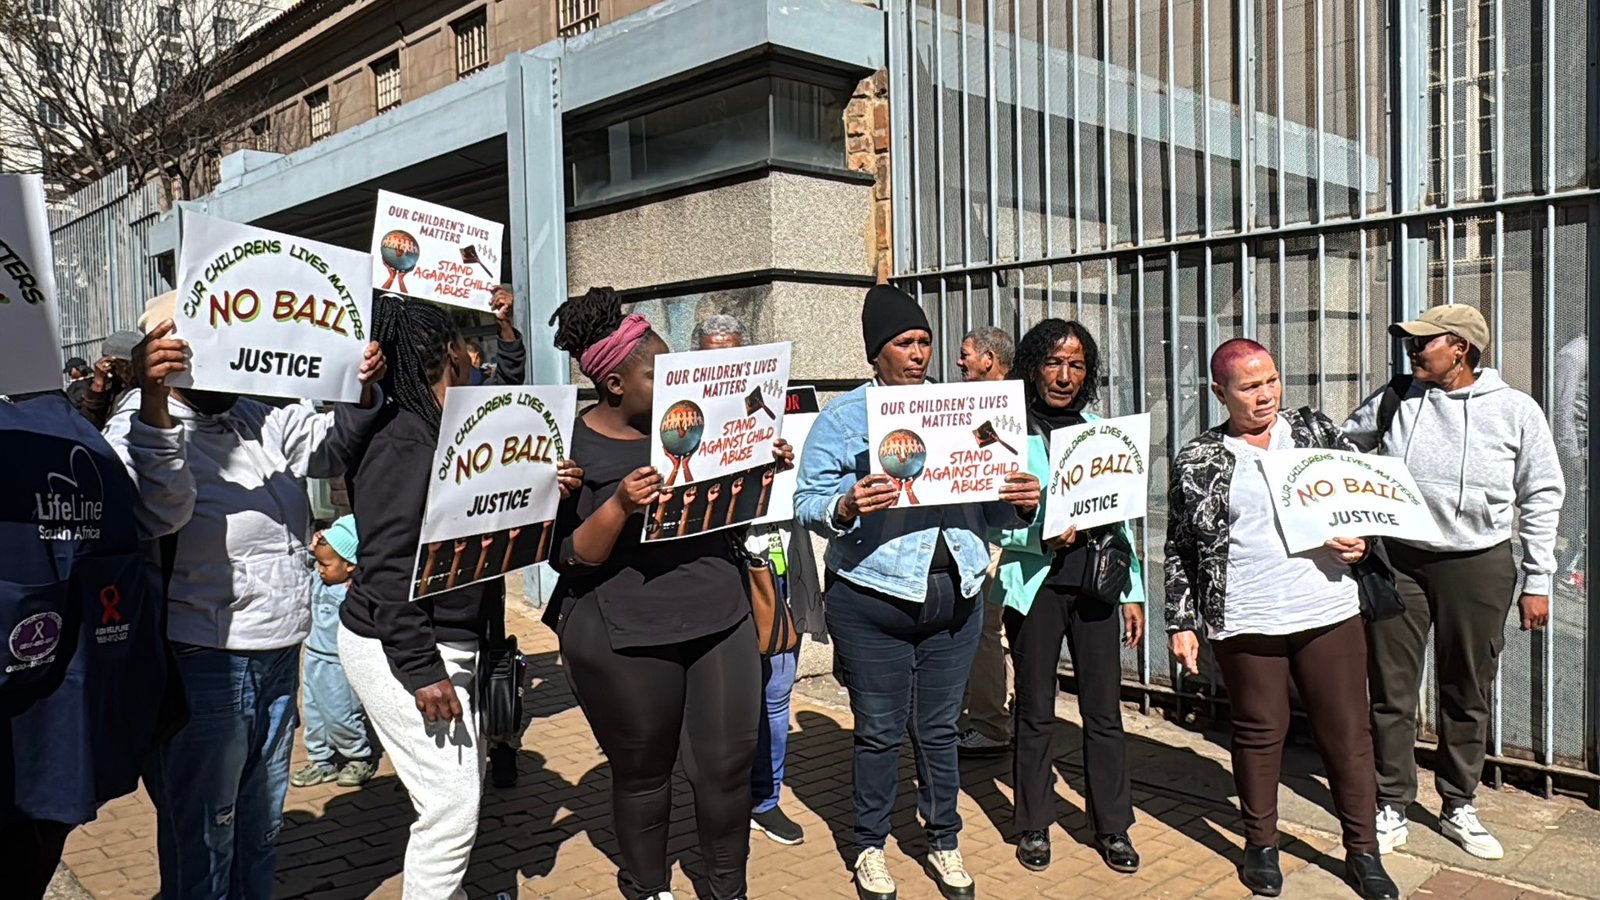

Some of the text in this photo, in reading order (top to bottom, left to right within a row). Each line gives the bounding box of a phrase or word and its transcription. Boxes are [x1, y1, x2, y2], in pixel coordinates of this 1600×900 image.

[388, 205, 489, 241] OUR CHILDREN'S LIVES
[420, 225, 461, 244] MATTERS
[413, 267, 463, 286] AGAINST
[438, 260, 473, 276] STAND
[184, 239, 365, 341] OUR CHILDRENS LIVES MATTERS
[435, 283, 471, 299] ABUSE
[209, 288, 349, 337] NO BAIL
[230, 347, 322, 378] JUSTICE
[666, 358, 778, 386] OUR CHILDREN'S LIVES
[703, 379, 748, 399] MATTERS
[881, 395, 1008, 416] OUR CHILDREN'S LIVES
[722, 416, 757, 436] STAND
[922, 413, 972, 428] MATTERS
[439, 445, 457, 481] OUR
[455, 392, 513, 446] CHILDRENS
[517, 392, 545, 413] LIVES
[698, 427, 774, 456] AGAINST CHILD
[455, 434, 554, 485] NO BAIL
[720, 445, 754, 466] ABUSE
[949, 450, 993, 465] STAND
[1050, 425, 1145, 495] OUR CHILDRENS LIVES MATTERS
[1287, 453, 1334, 483] CHILDRENS
[1340, 454, 1372, 470] LIVES
[923, 462, 1019, 482] AGAINST CHILD
[1061, 454, 1134, 496] NO BAIL
[951, 478, 994, 495] ABUSE
[1296, 478, 1406, 507] NO BAIL
[35, 493, 103, 520] LifeLine
[467, 487, 532, 517] JUSTICE
[1070, 493, 1119, 518] JUSTICE
[1328, 510, 1400, 527] JUSTICE
[74, 525, 100, 540] Africa
